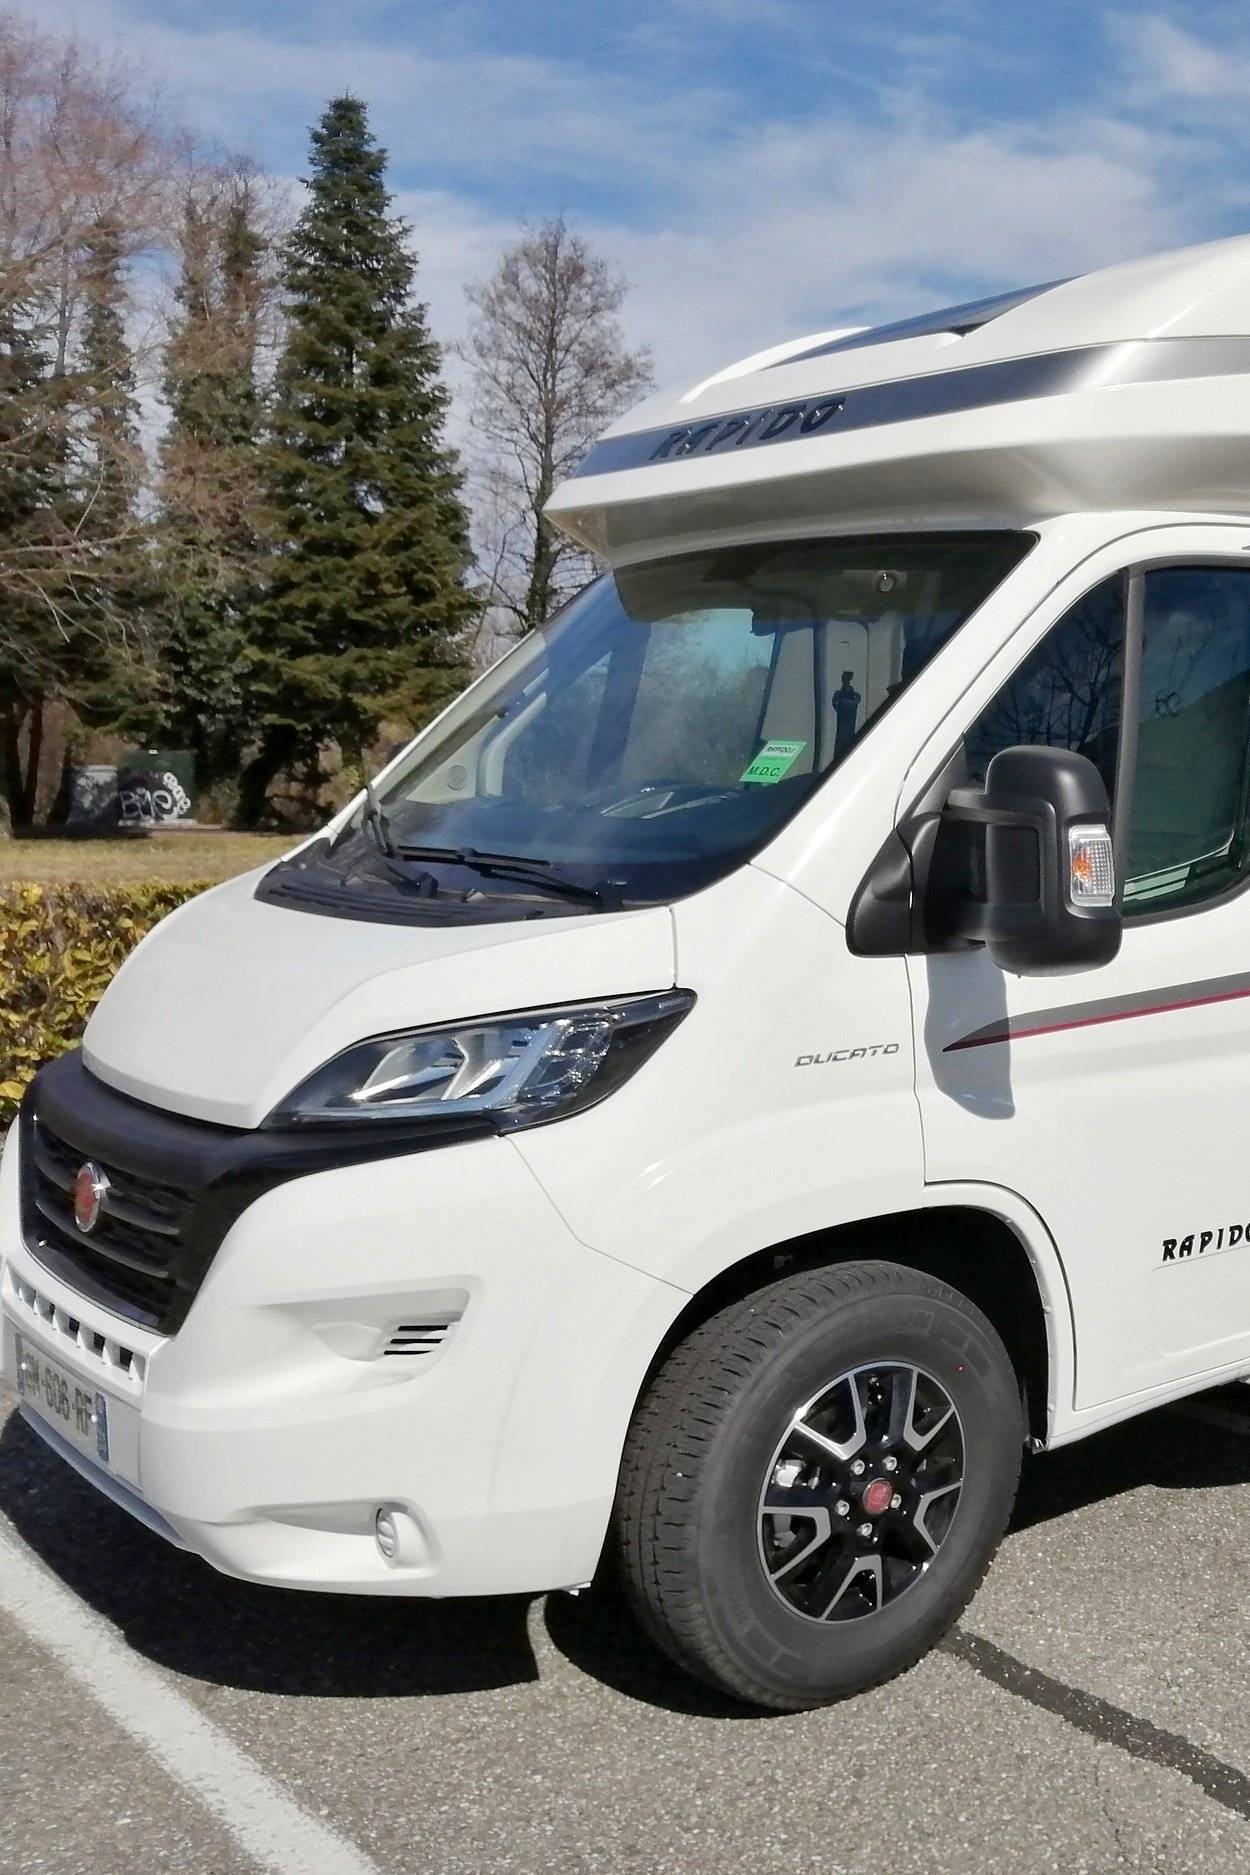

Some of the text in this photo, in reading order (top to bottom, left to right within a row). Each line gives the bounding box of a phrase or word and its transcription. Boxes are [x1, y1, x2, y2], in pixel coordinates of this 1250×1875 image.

[647, 396, 847, 461] RAPIDO
[747, 766, 780, 777] M.D.C.
[794, 1043, 900, 1067] DUCATO
